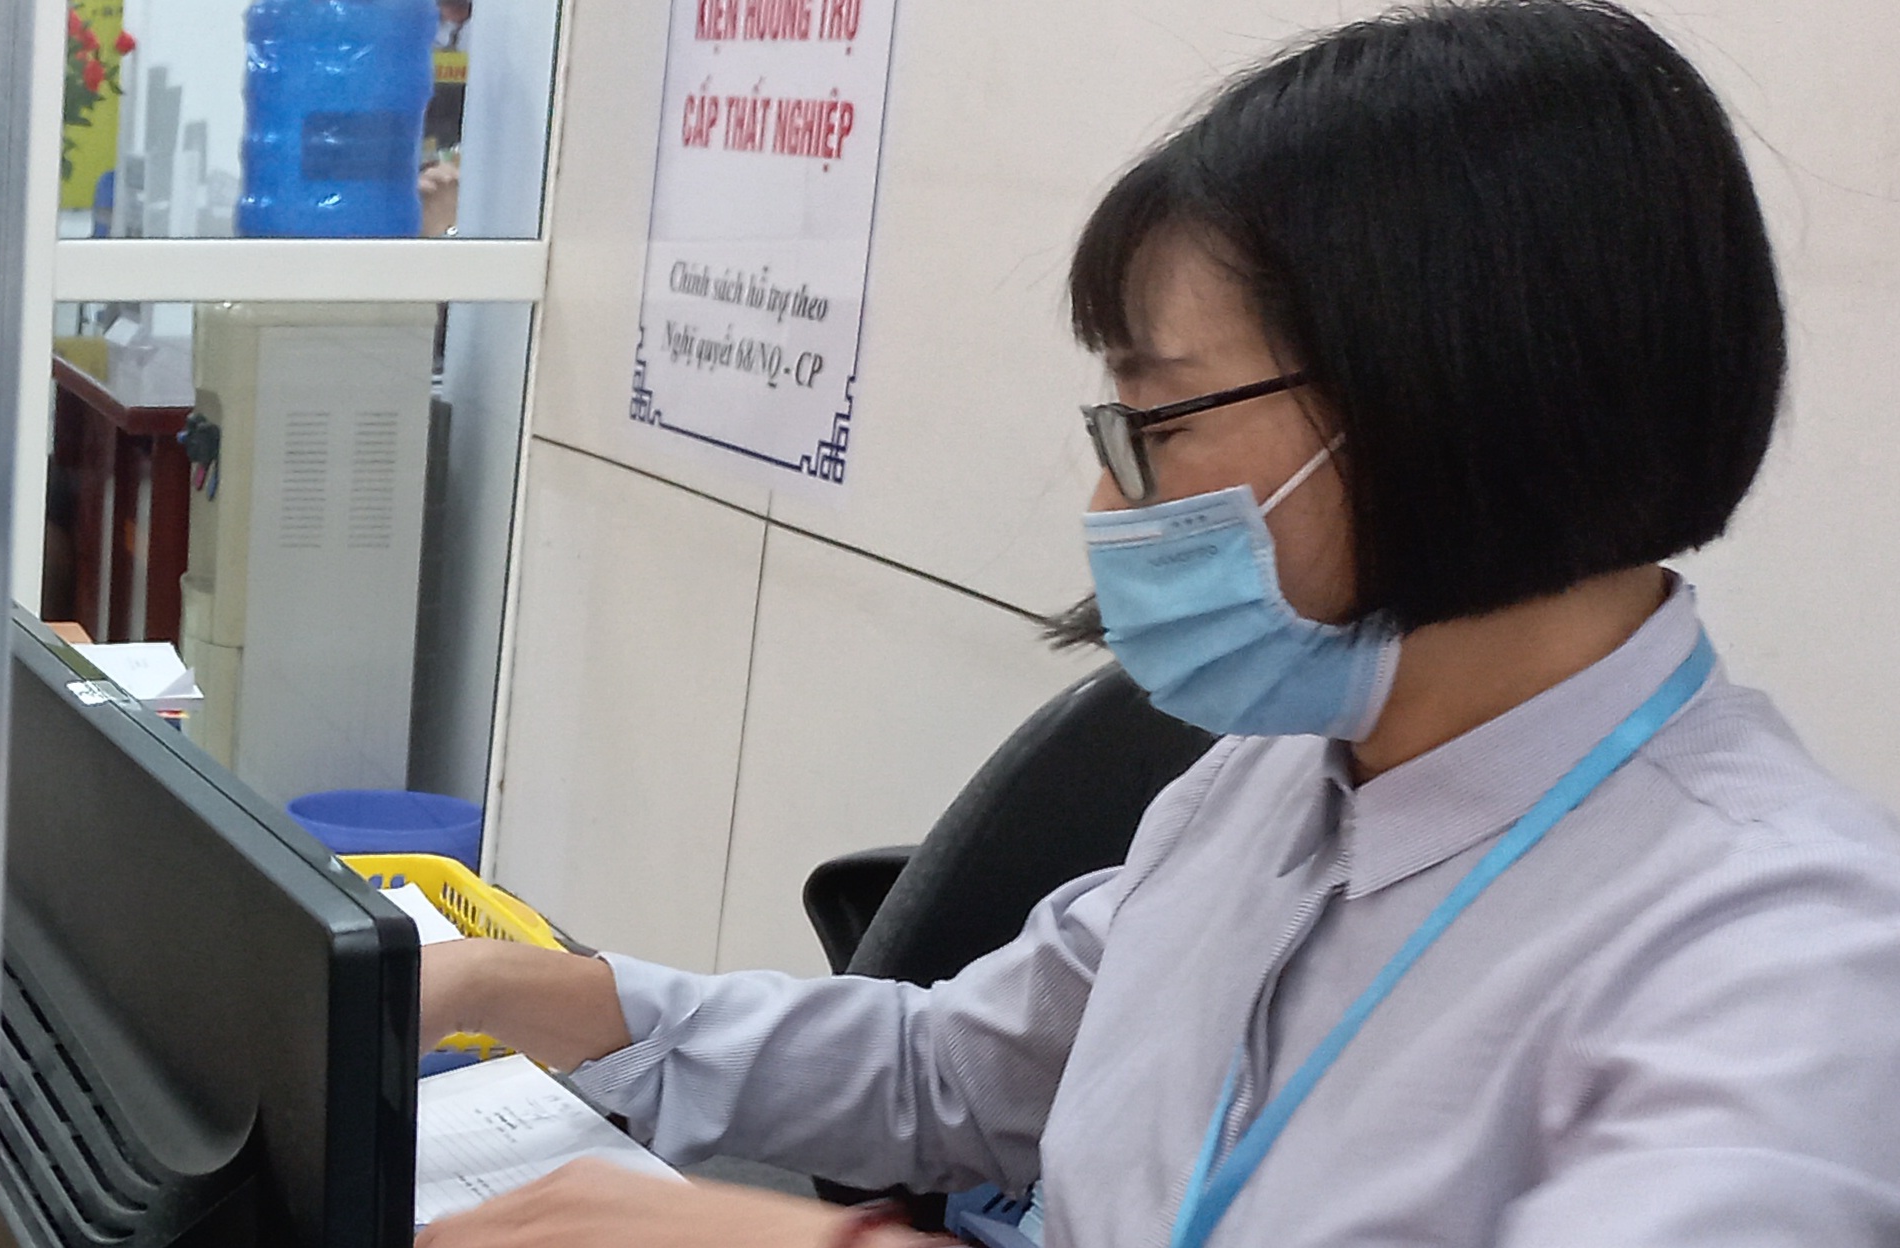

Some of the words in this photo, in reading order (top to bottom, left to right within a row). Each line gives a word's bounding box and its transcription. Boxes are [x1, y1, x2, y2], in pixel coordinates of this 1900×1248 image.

[682, 74, 719, 148] CẤP
[724, 75, 771, 152] THẤT
[773, 87, 854, 173] NGHIỆP
[713, 268, 743, 305] sách
[791, 283, 828, 322] theo
[795, 351, 823, 388] CP
